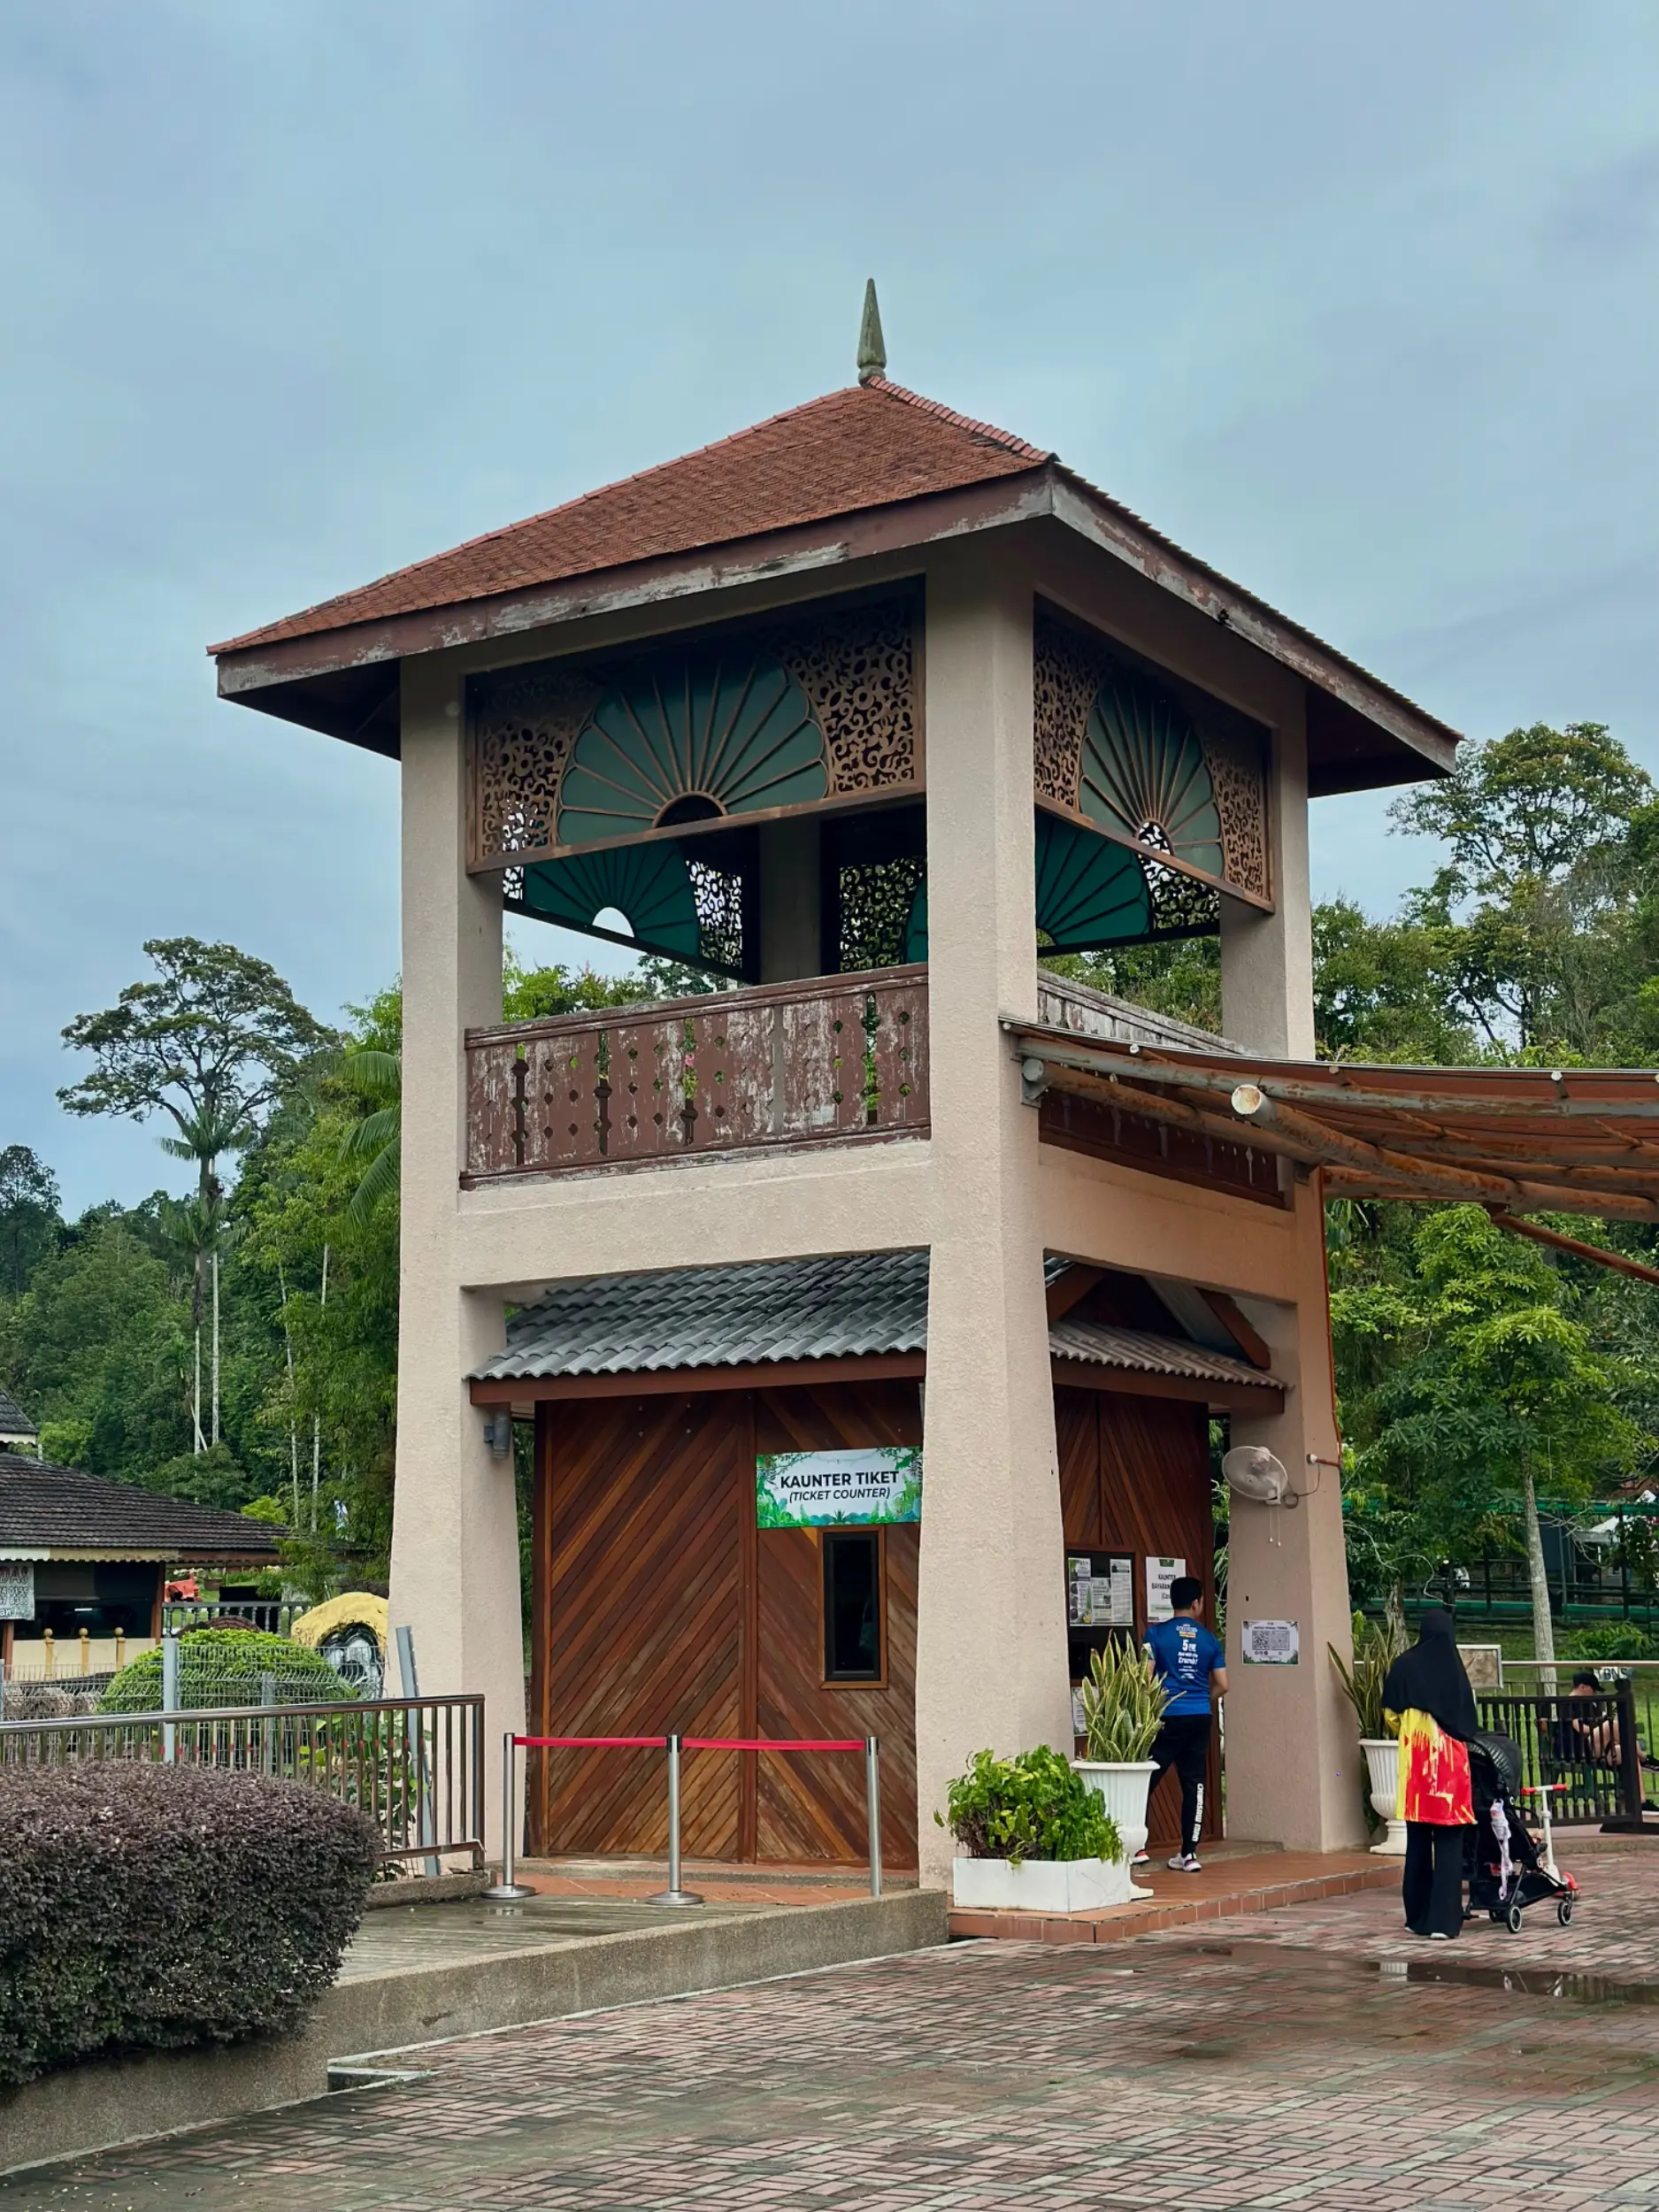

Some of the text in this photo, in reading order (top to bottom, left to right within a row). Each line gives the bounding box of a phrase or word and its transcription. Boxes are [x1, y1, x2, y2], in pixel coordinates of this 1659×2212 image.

[780, 1471, 899, 1489] KAUNTER TIKET
[789, 1486, 890, 1503] (TICKET COUNTER)
